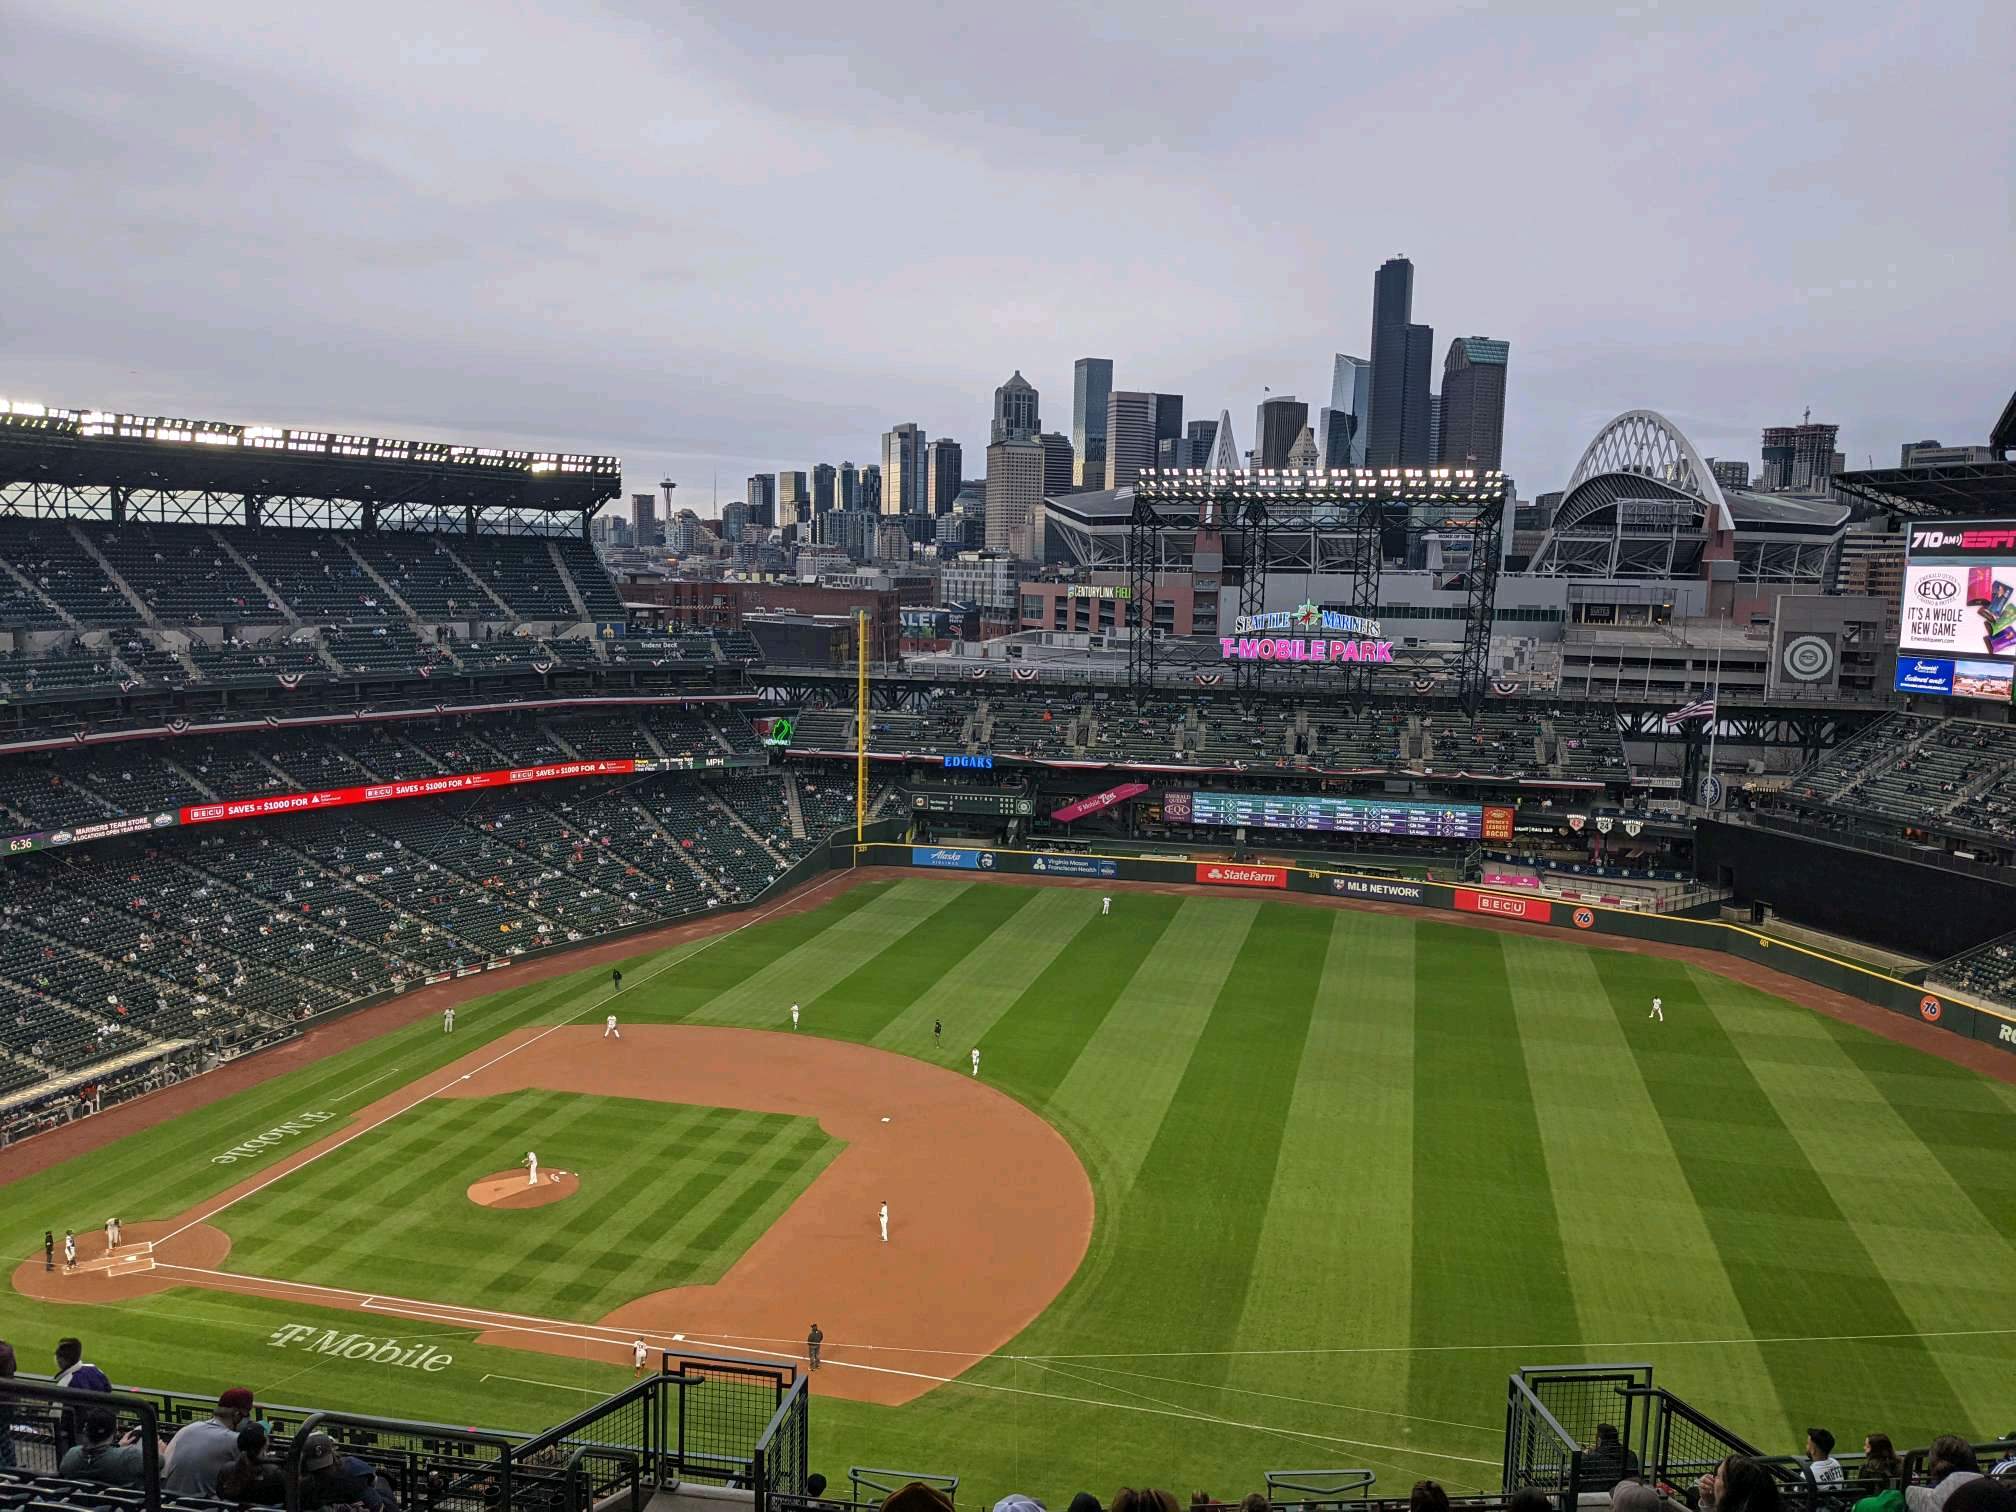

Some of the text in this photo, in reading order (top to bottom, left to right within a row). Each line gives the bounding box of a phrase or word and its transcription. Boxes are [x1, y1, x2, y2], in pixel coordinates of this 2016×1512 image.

[1911, 532, 1943, 548] 710
[1943, 536, 1956, 544] AM
[1074, 585, 1114, 598] CENTURYLINK
[1919, 580, 1957, 600] EQC
[1908, 608, 1963, 622] IT'S A WHOLE
[1235, 610, 1381, 637] SEATTLE MARINERS
[1911, 622, 1956, 637] NEW GAME
[1219, 637, 1394, 663] T-MOBILE PARK
[706, 758, 723, 767] MPH
[536, 769, 555, 777] SAVES
[396, 785, 418, 794] SAVES
[425, 782, 447, 791] $1000
[193, 809, 222, 818] BECU
[228, 805, 255, 815] SAVES
[263, 801, 290, 812] $1000
[291, 798, 308, 807] FOR
[1166, 804, 1190, 815] EQC
[76, 824, 109, 835] MARINERS
[110, 821, 127, 829] TEAM
[128, 817, 147, 826] STORE
[77, 831, 105, 840] LOCATIONS
[134, 823, 151, 831] ROUND
[11, 838, 32, 850] 6:36
[931, 850, 961, 861] Alaska
[1347, 882, 1419, 898] MLB NETWORK
[1481, 898, 1523, 912] BECU
[1576, 912, 1591, 923] 76
[1923, 1003, 1938, 1015] 76
